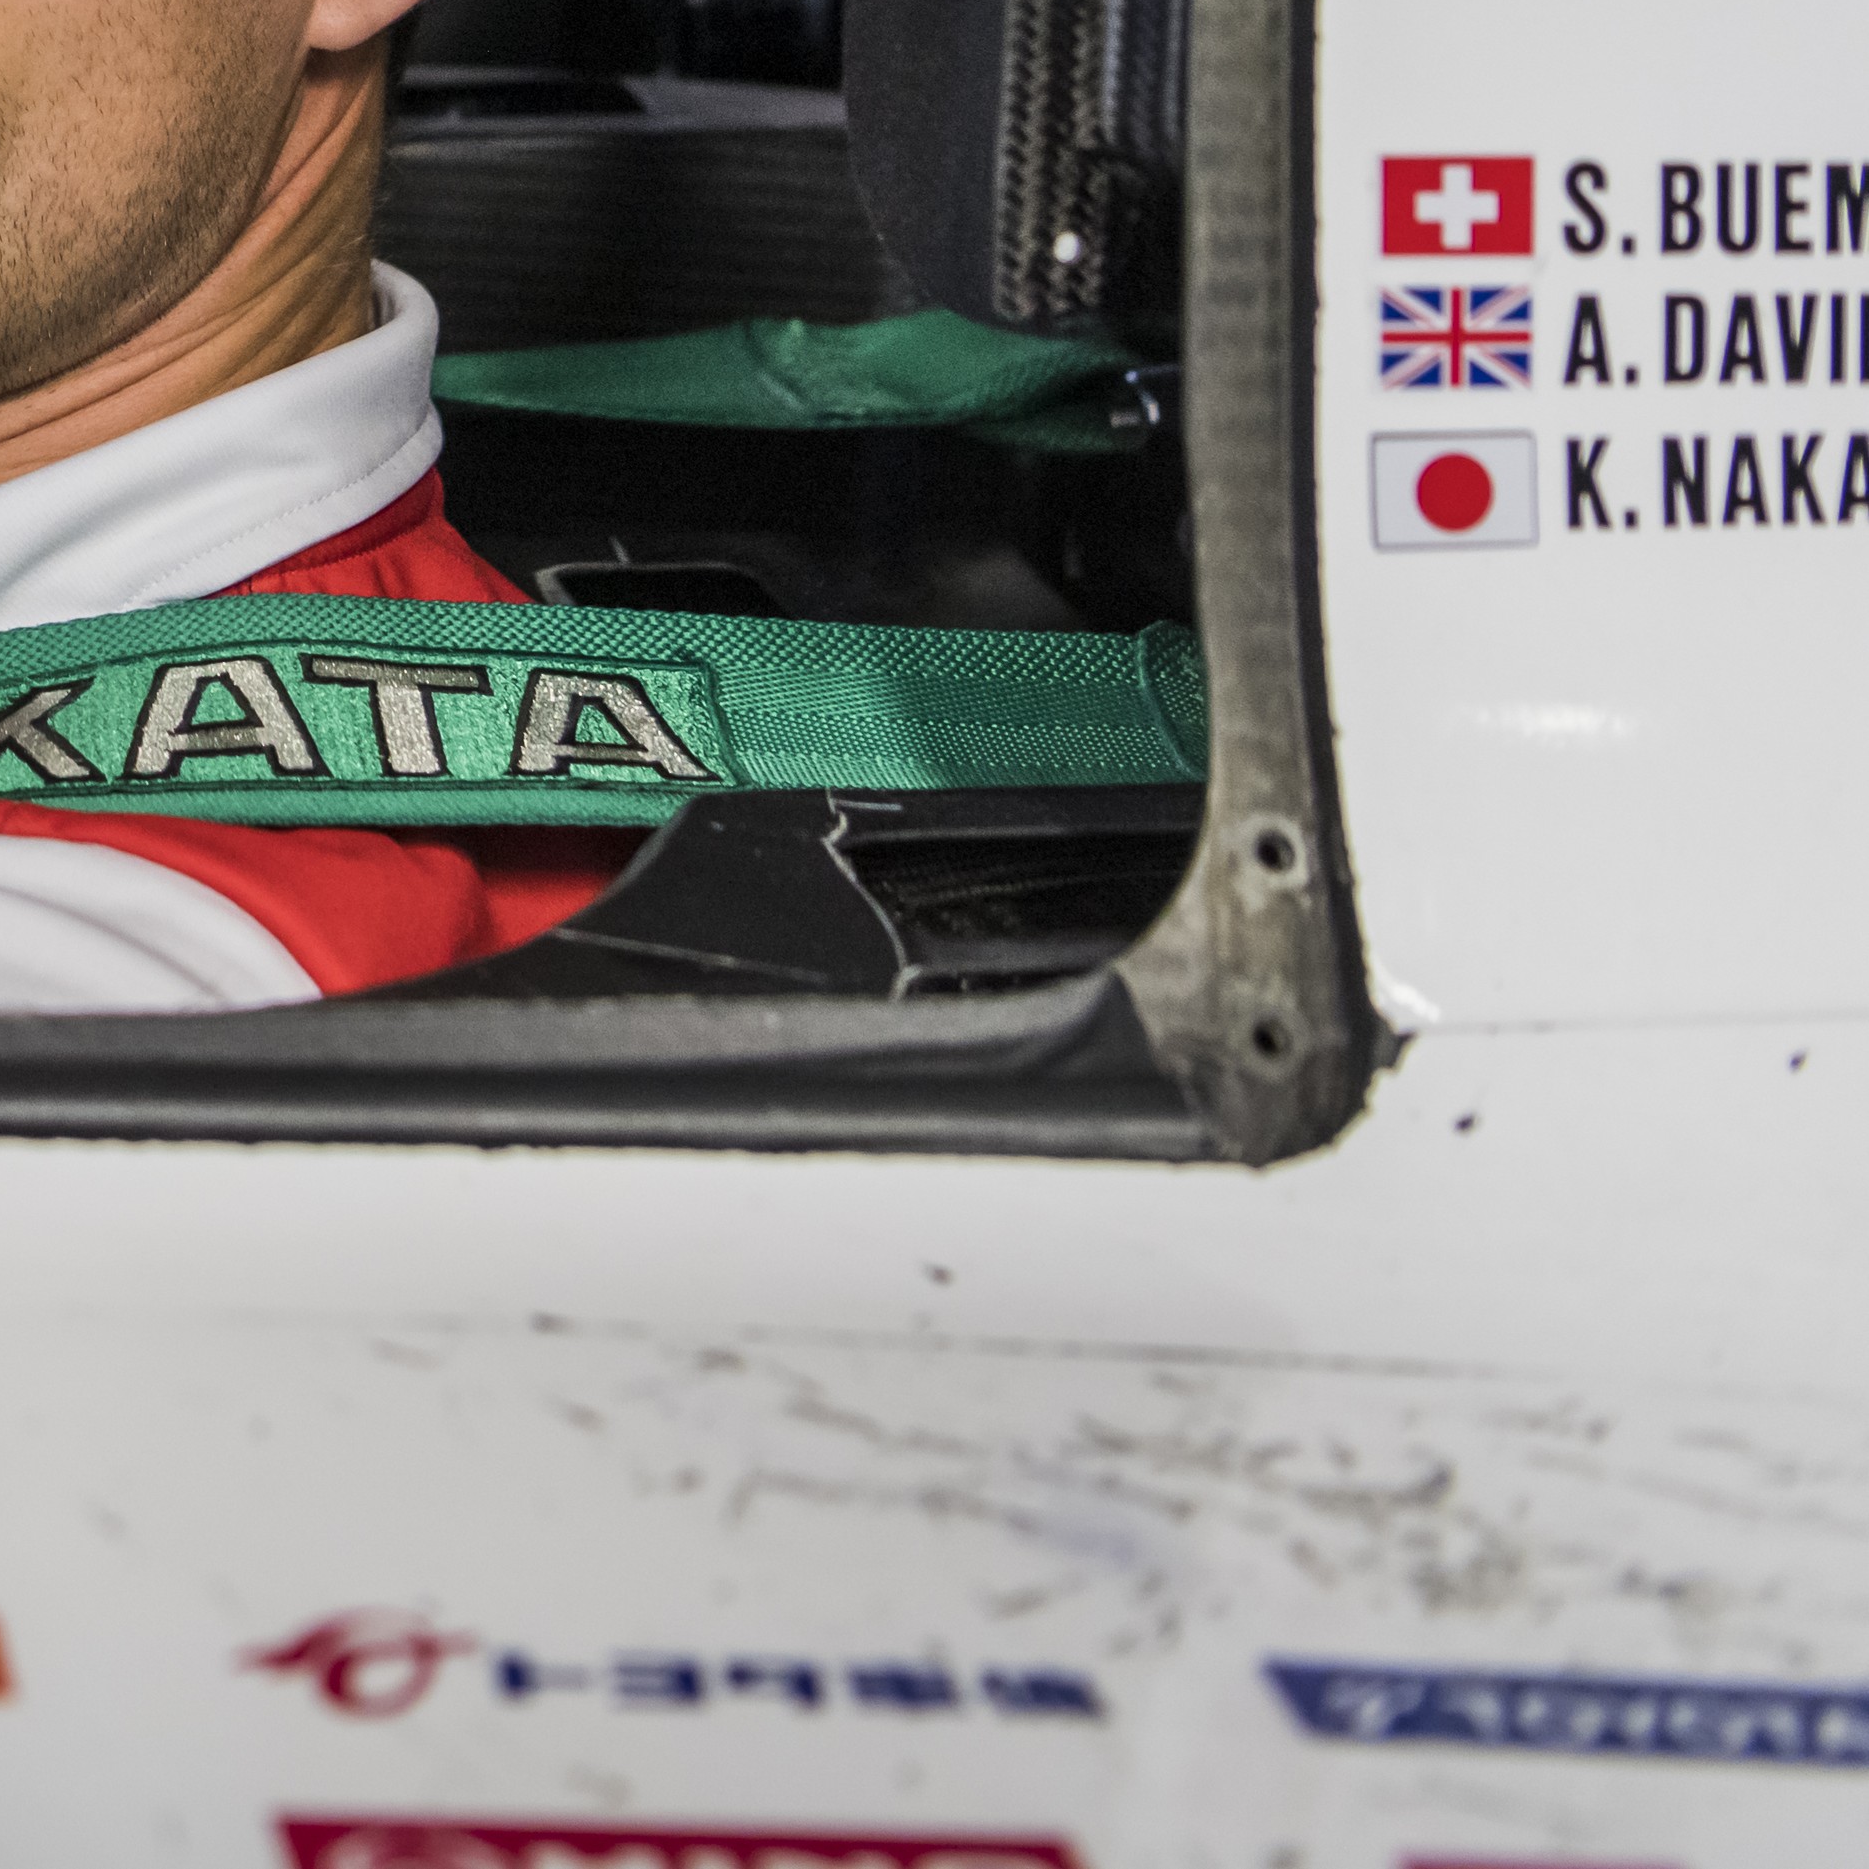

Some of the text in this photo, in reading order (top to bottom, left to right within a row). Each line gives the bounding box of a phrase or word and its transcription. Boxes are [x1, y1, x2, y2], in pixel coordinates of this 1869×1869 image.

[1562, 160, 1869, 255] S. BUEM
[1564, 293, 1640, 386] A.
[1566, 435, 1869, 530] K. NAKA
